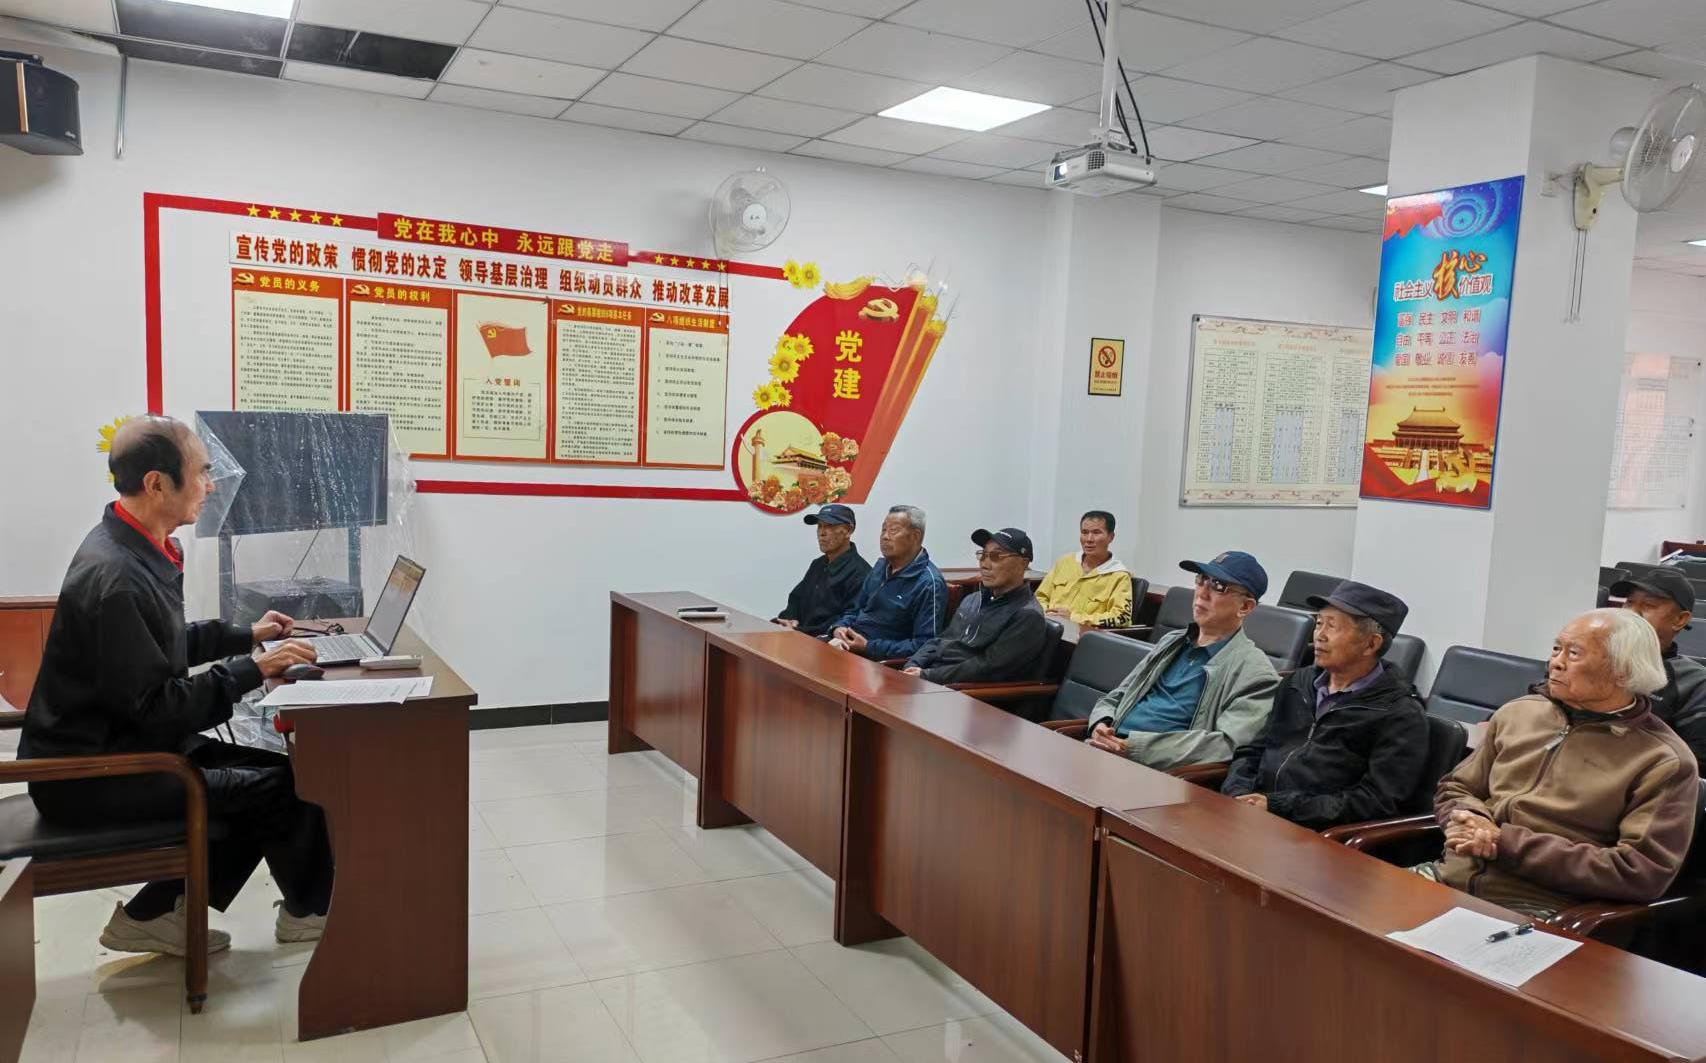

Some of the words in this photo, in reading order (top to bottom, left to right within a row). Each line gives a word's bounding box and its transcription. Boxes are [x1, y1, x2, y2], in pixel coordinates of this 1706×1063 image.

[394, 217, 499, 248] 党在我心中
[516, 232, 614, 262] 永远跟党走
[236, 234, 338, 269] 宣传党的政策
[458, 258, 548, 290] 领导基层治理
[559, 268, 642, 299] 组织动员群众
[652, 279, 729, 309] 推动改革发展
[259, 275, 320, 293] 党员的义务
[373, 286, 431, 303] 党员的权利
[832, 330, 864, 399] 党建
